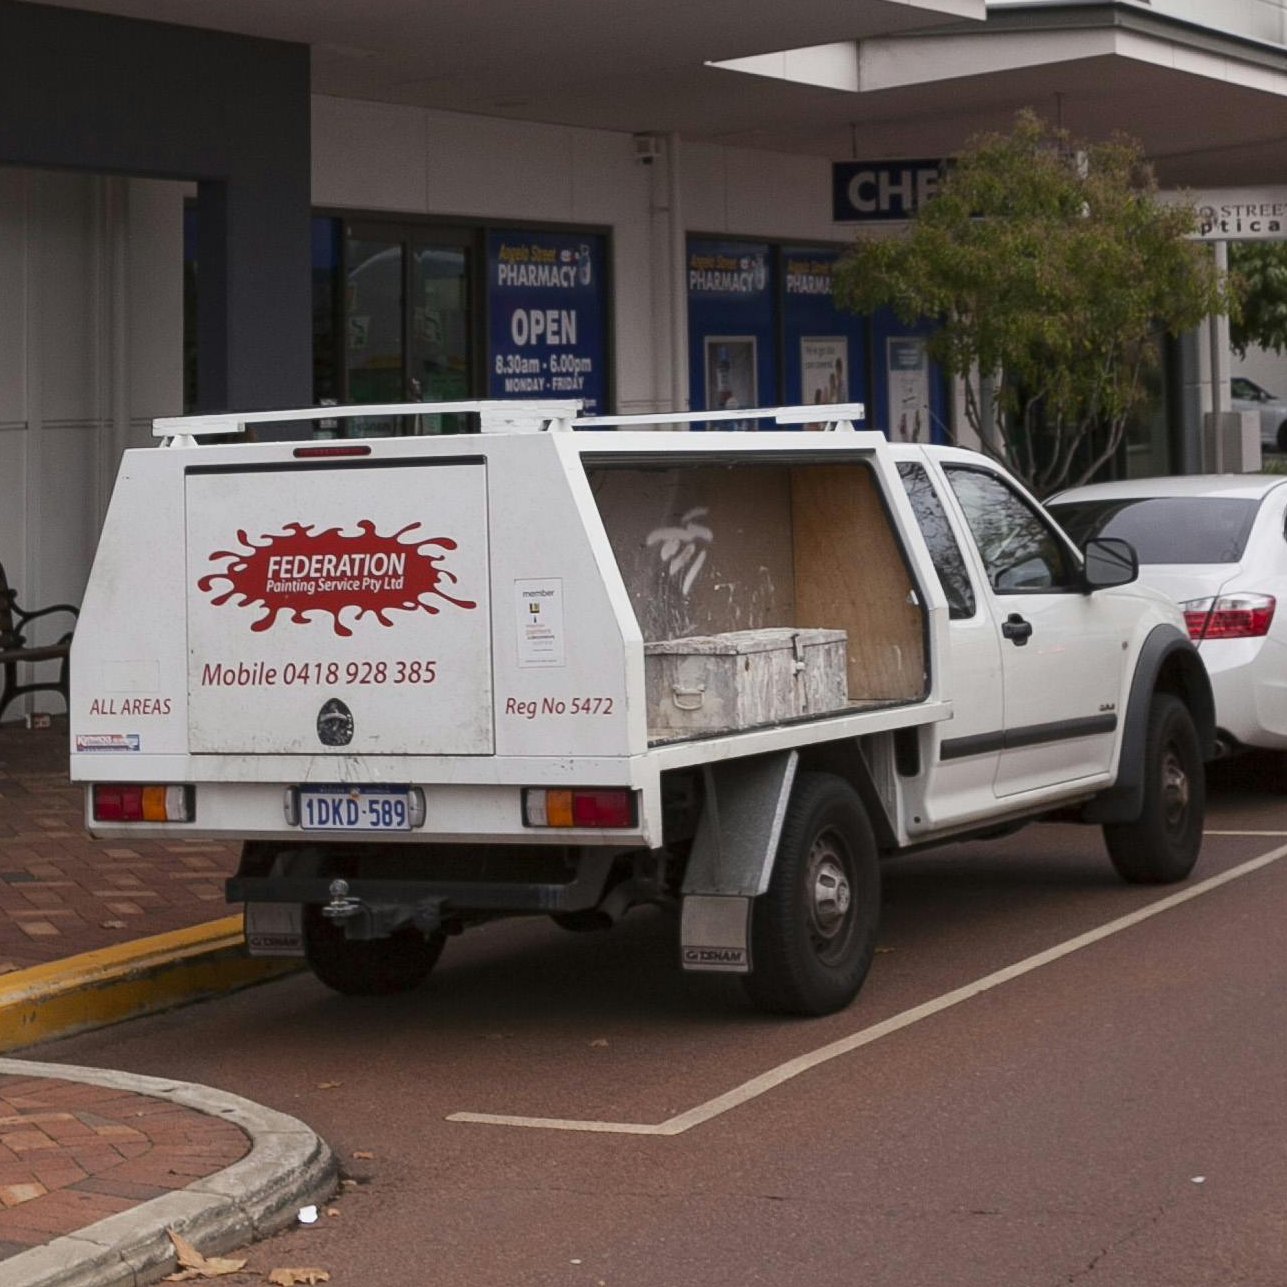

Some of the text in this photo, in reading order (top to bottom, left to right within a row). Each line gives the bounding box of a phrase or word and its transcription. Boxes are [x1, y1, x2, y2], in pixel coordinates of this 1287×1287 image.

[498, 264, 577, 287] PHARMACY
[690, 271, 755, 292] PHARMACY
[786, 274, 833, 295] PHARMA
[511, 308, 577, 346] OPEN
[495, 354, 540, 375] 8.30am
[550, 354, 592, 377] 6.00pm
[505, 376, 544, 393] MONDAY
[552, 376, 585, 391] FRIDAY
[267, 552, 406, 579] FEDERATION
[266, 575, 405, 595] Painting Service Pty Ltd
[201, 660, 437, 686] Mobile 0418 928 385
[89, 698, 172, 715] ALL AREAS
[505, 697, 614, 719] Reg No 5472
